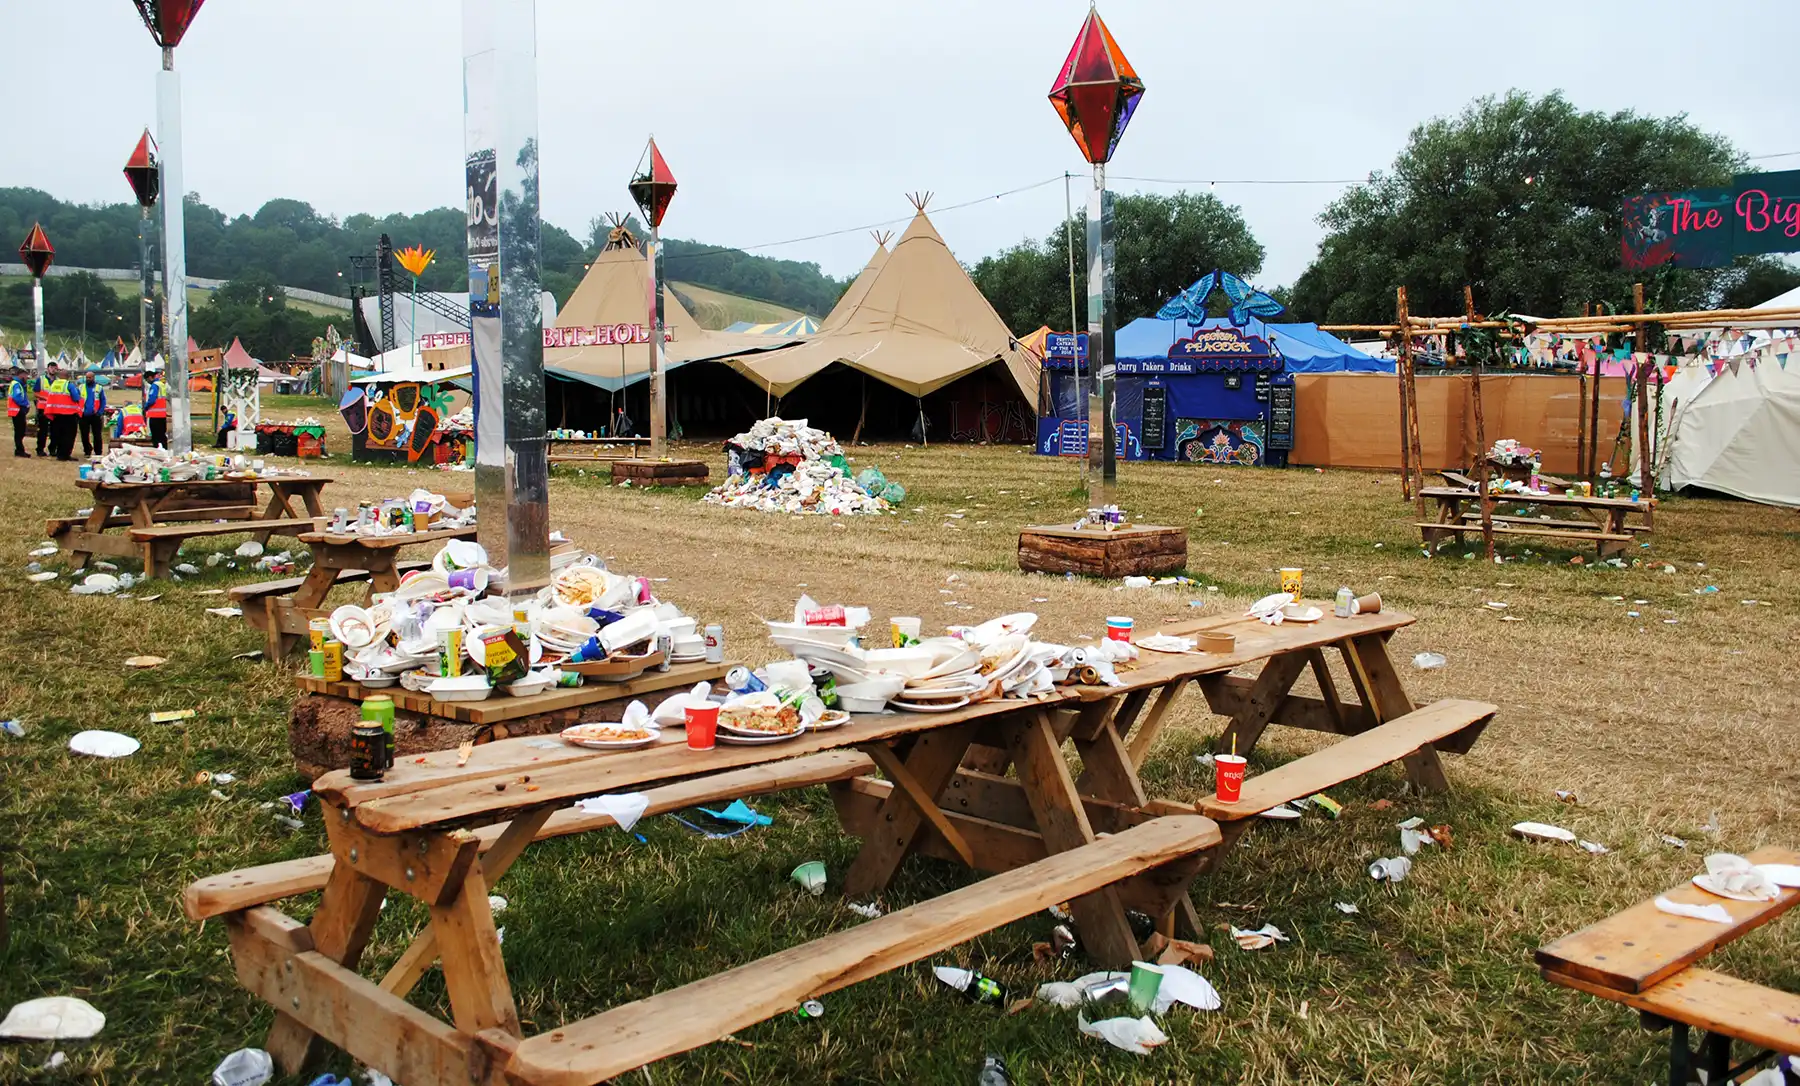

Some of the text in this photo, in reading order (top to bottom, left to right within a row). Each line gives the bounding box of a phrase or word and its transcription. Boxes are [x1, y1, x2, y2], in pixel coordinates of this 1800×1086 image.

[1666, 189, 1800, 237] The Big
[593, 323, 670, 345] HOL
[1185, 341, 1252, 353] PEACOCK
[1117, 362, 1192, 373] Curry Pakora Drinks
[1223, 771, 1244, 780] enjoy
